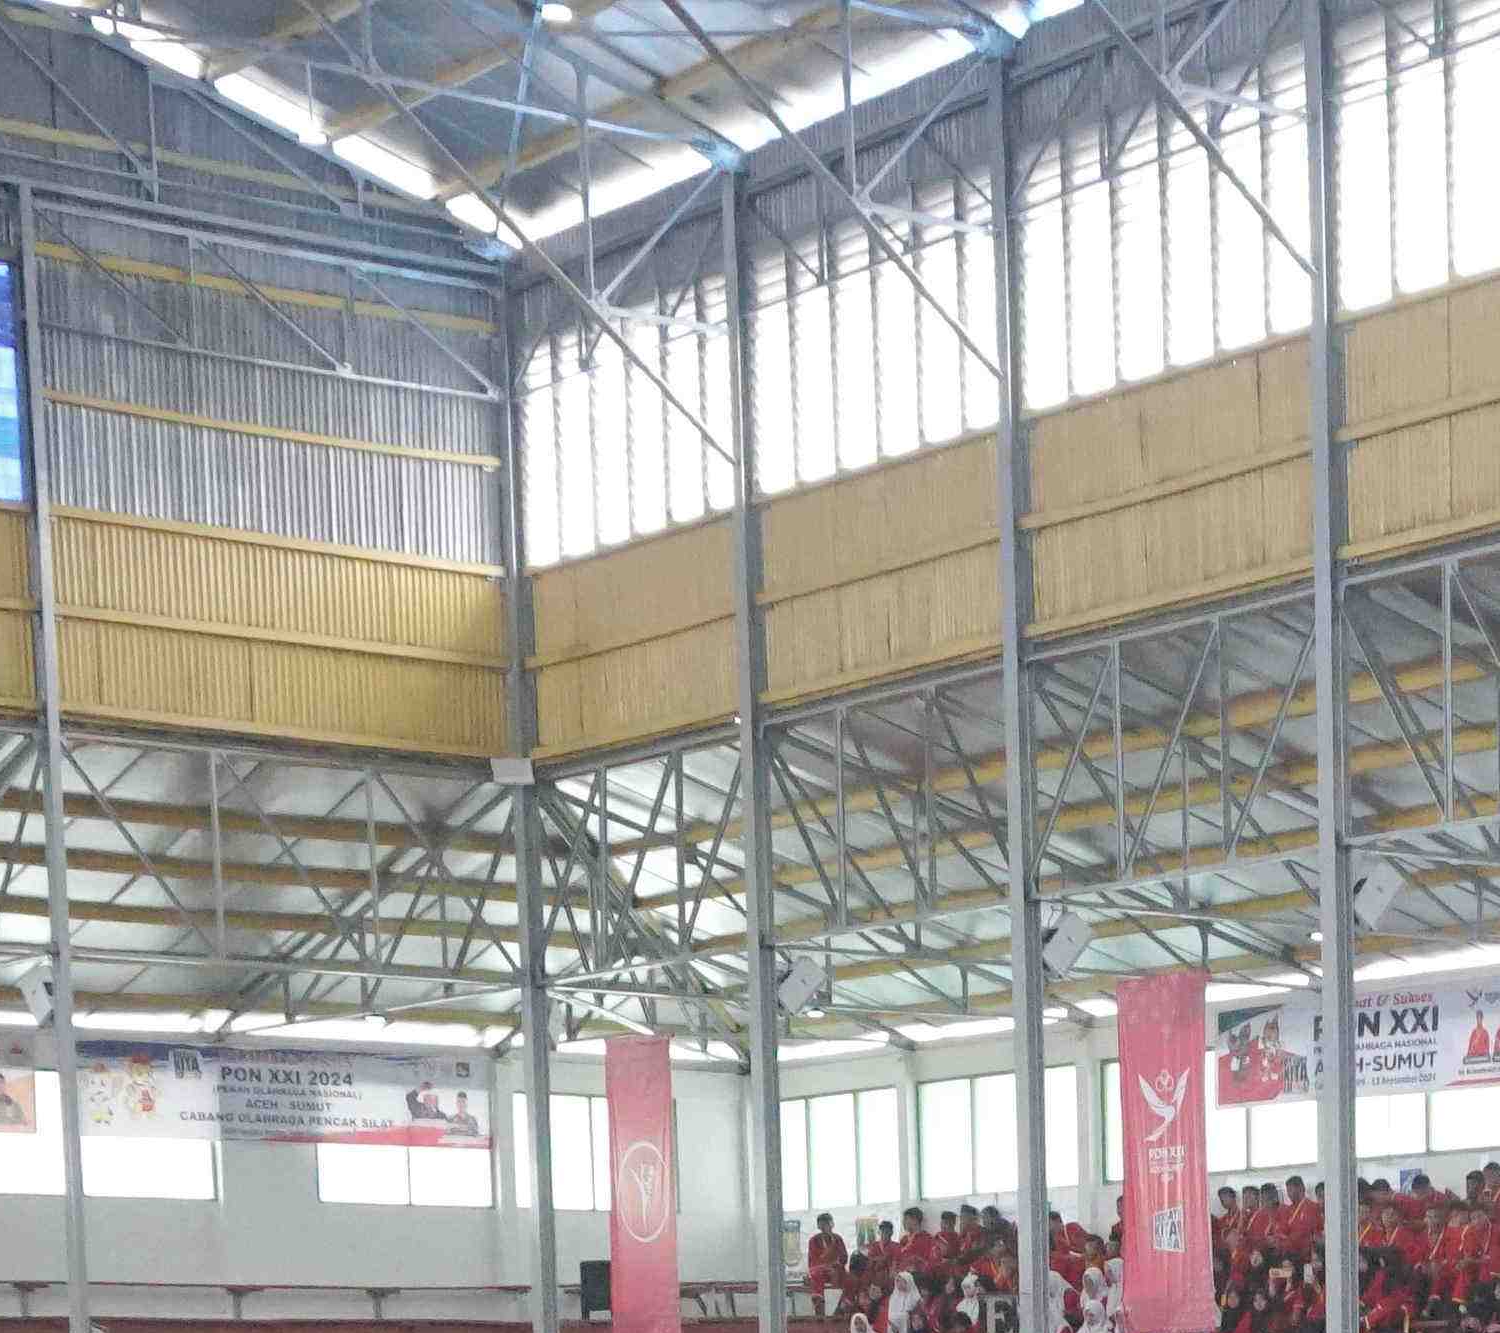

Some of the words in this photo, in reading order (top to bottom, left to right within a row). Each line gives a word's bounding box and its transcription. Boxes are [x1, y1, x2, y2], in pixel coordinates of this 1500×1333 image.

[1388, 1005, 1439, 1036] XXI
[221, 1066, 262, 1083] PON
[268, 1068, 300, 1083] XXI
[308, 1070, 354, 1086] 2024
